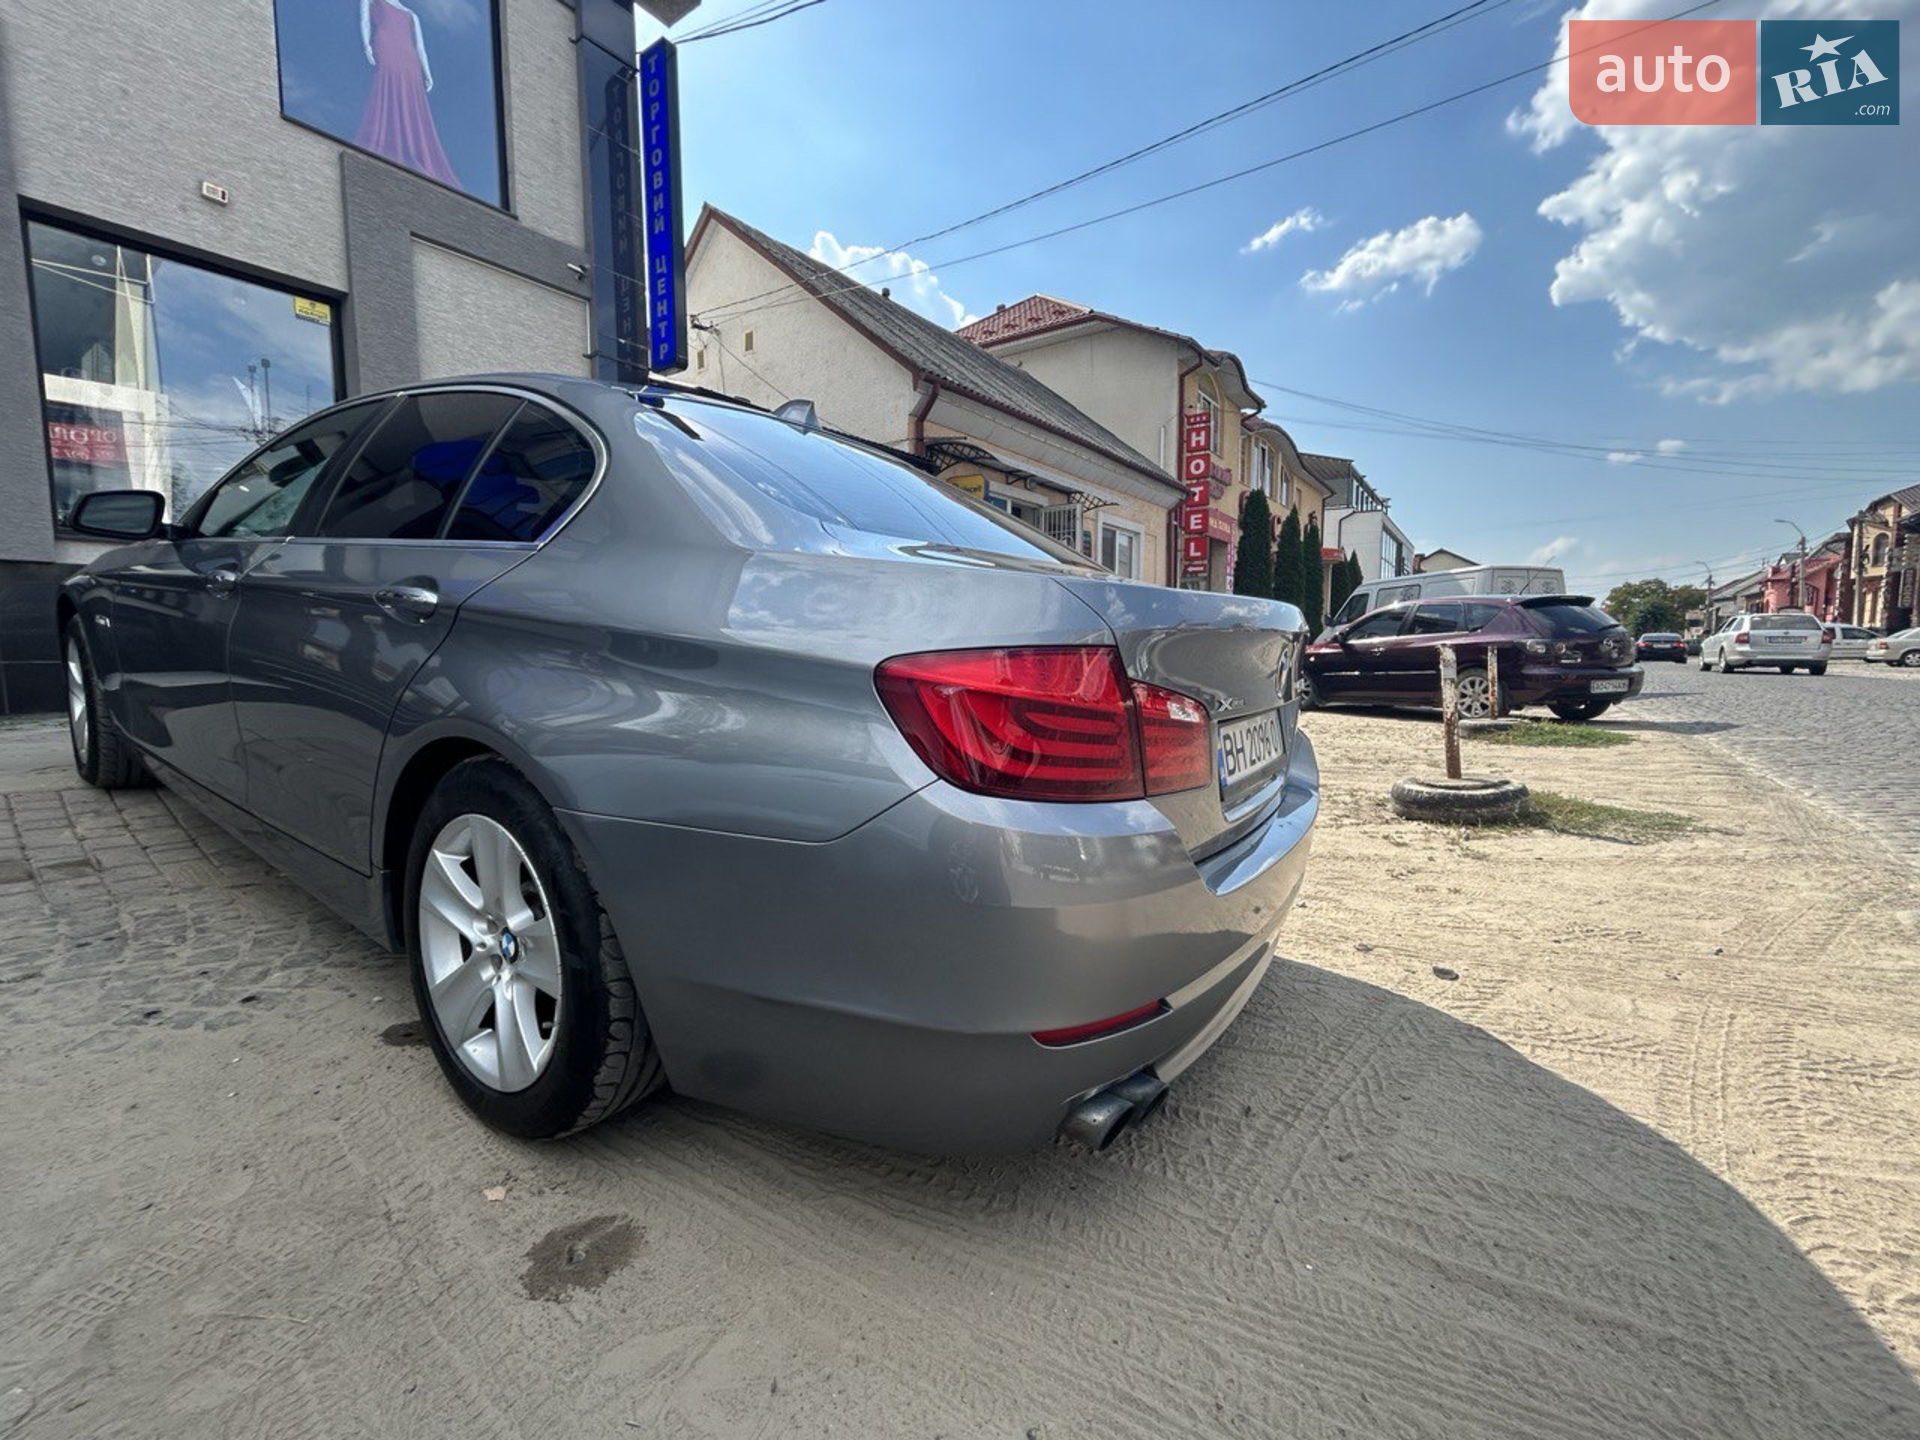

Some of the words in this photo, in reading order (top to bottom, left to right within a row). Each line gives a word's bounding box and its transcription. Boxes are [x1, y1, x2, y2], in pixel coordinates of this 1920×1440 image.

[647, 52, 665, 234] ТОРГОВИЙ
[655, 256, 671, 360] ЦЕНТР
[1189, 430, 1205, 557] HOTEL
[1223, 730, 1247, 777] BH
